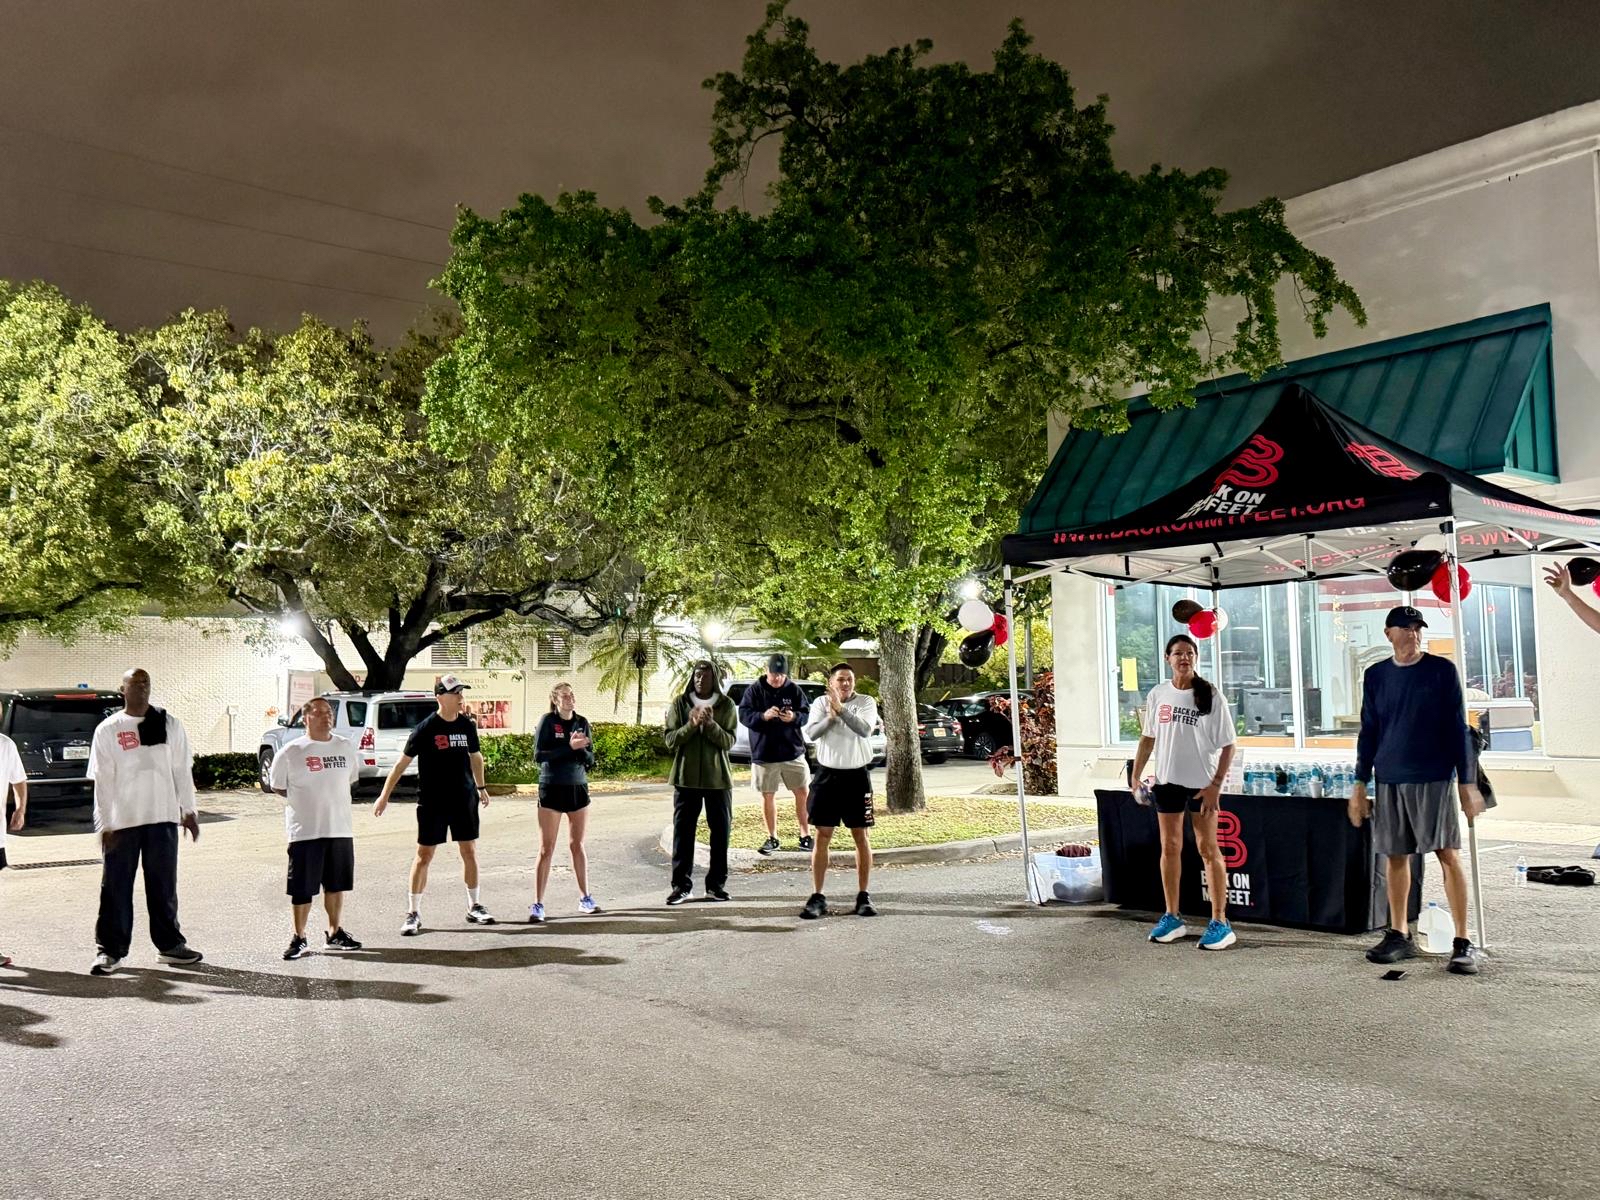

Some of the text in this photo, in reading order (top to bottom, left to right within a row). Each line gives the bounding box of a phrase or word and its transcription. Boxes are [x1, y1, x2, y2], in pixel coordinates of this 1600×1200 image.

[1234, 490, 1266, 505] ON
[1204, 497, 1258, 516] FEET
[1172, 714, 1181, 723] MY
[1173, 706, 1190, 716] BACK
[1200, 870, 1250, 890] BK ON
